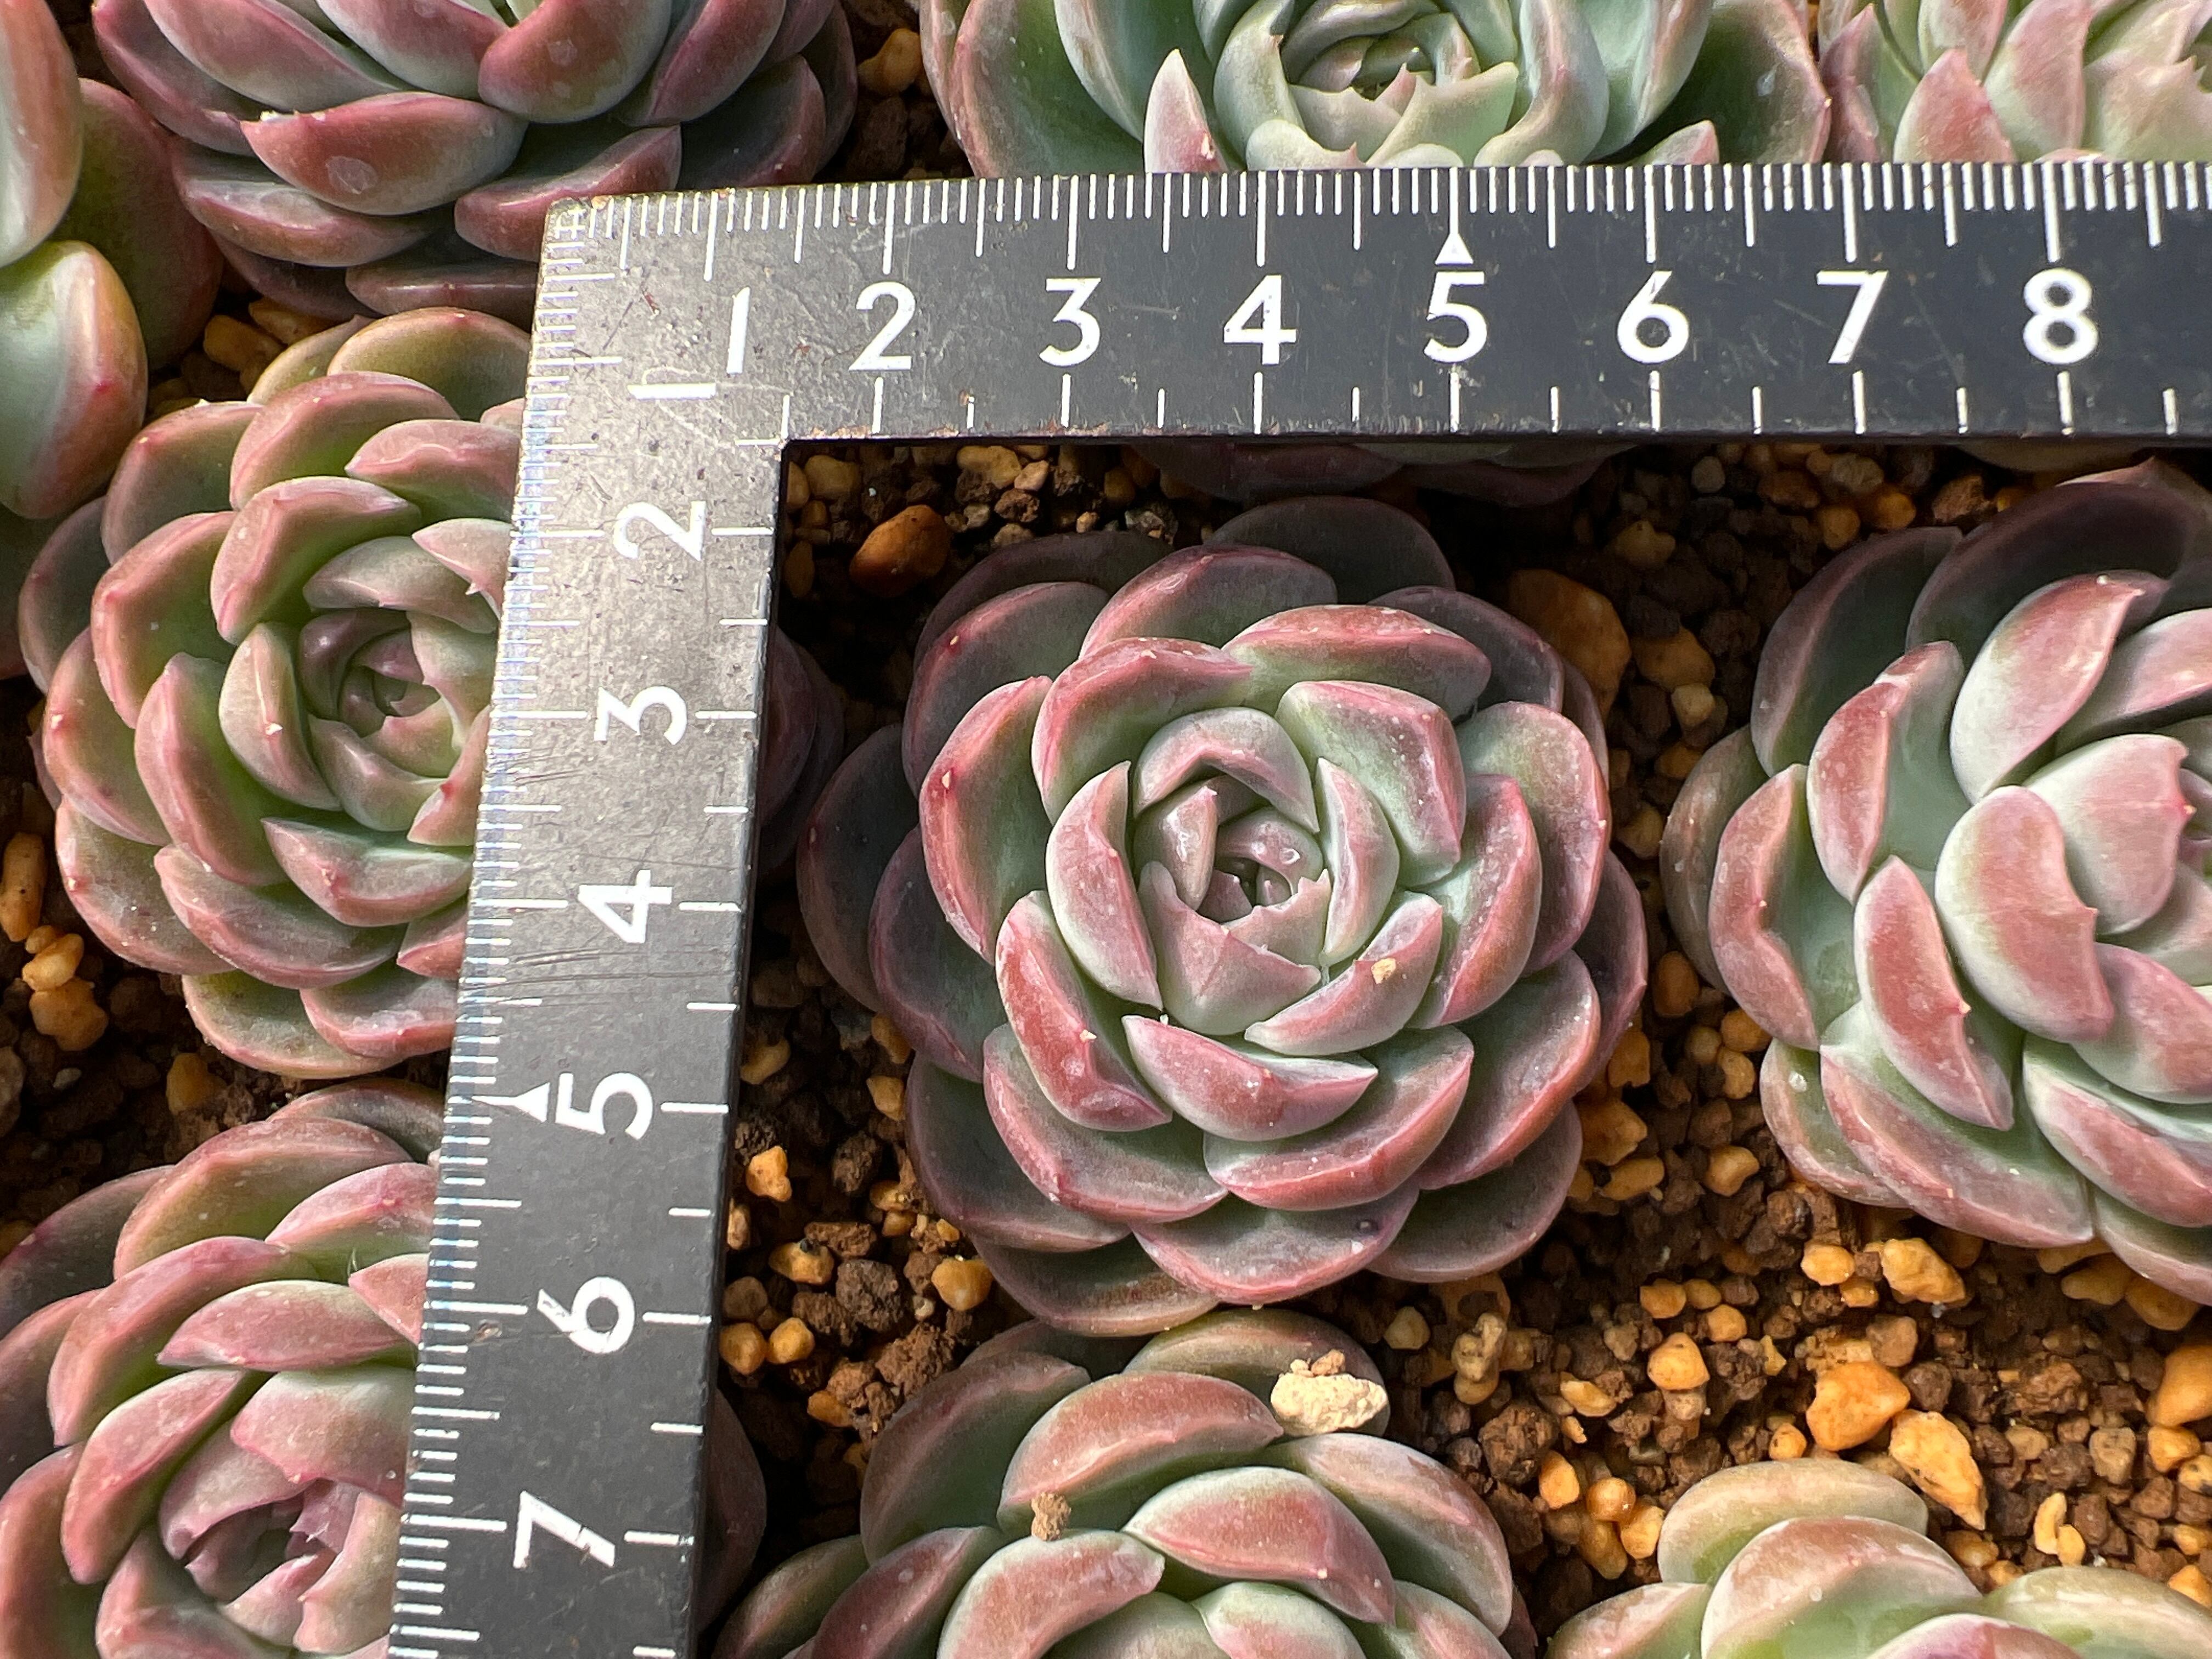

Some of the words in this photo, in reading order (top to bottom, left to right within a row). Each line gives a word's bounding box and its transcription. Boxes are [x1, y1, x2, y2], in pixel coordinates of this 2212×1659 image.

[726, 287, 750, 374] 1
[849, 281, 915, 371] 2
[1039, 278, 1101, 367] 3
[1223, 275, 1296, 365] 4
[1424, 270, 1487, 363] 5
[1617, 270, 1689, 363] 6
[1816, 270, 1888, 364] 7
[2022, 268, 2098, 364] 8
[627, 382, 715, 399] 1
[613, 500, 706, 561] 2
[594, 686, 688, 745] 3
[578, 869, 674, 944] 4
[555, 1072, 654, 1140] 5
[538, 1277, 635, 1354] 6
[514, 1490, 615, 1568] 7
